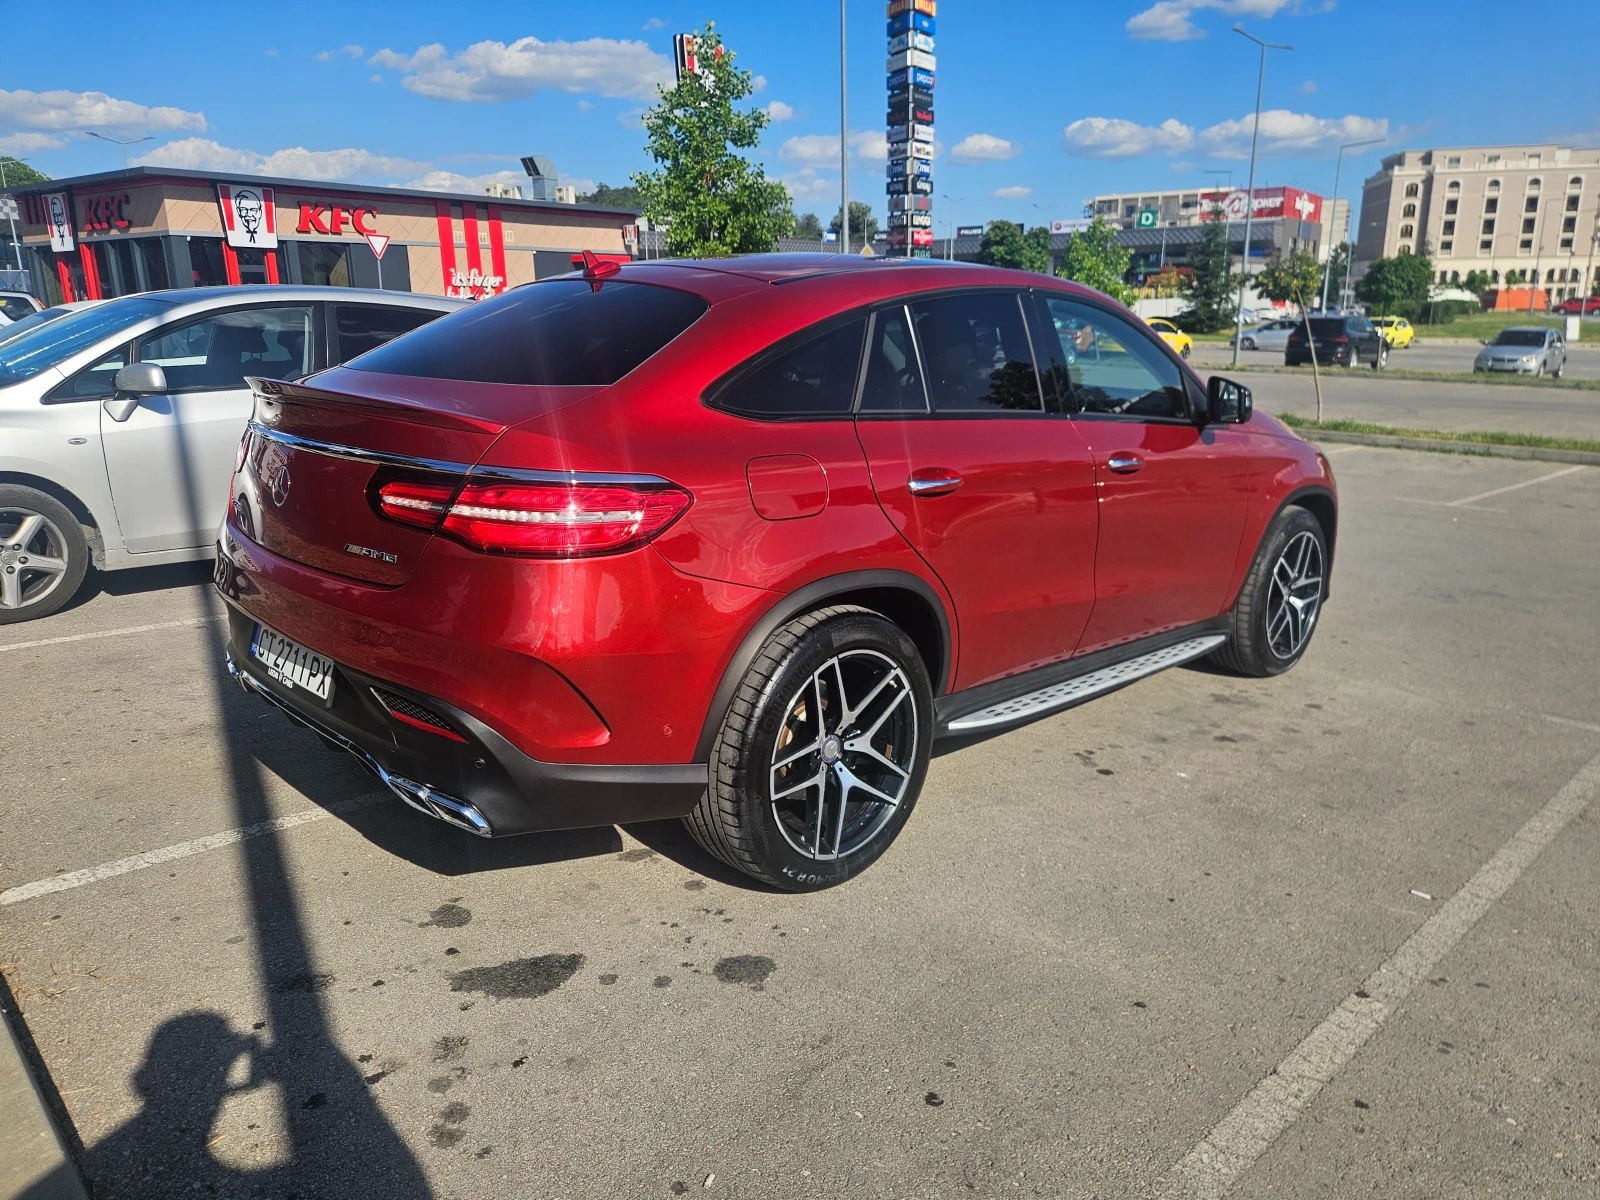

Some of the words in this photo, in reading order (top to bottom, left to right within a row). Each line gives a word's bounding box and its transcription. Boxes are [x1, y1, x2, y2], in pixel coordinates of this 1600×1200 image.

[84, 194, 129, 231] KFC
[297, 201, 378, 235] KFC
[1141, 212, 1153, 225] D
[469, 268, 503, 294] finger
[360, 546, 397, 563] AMG
